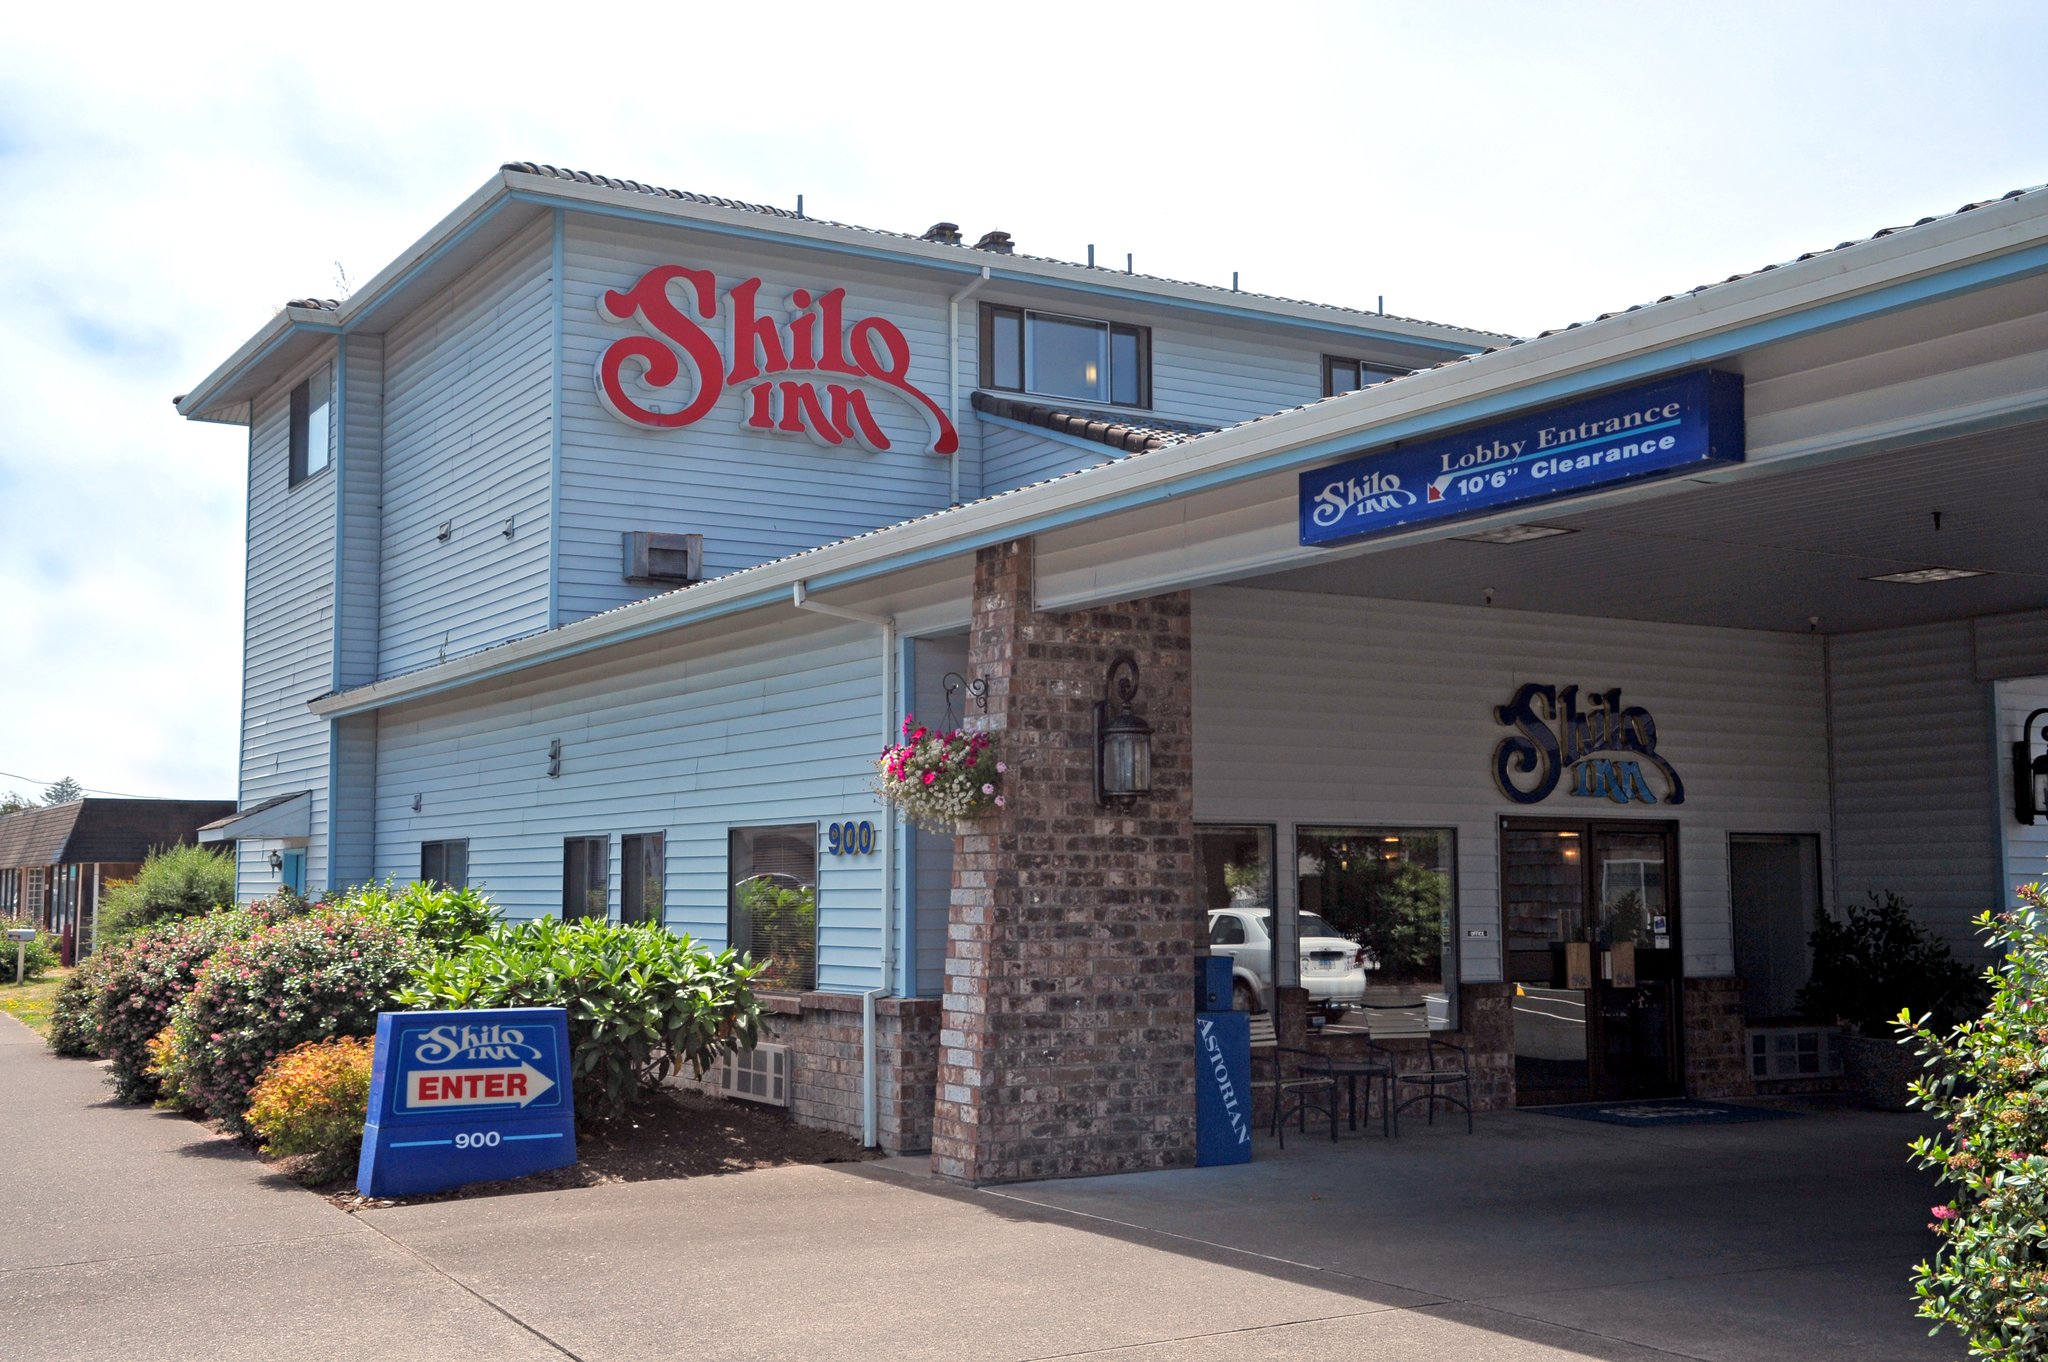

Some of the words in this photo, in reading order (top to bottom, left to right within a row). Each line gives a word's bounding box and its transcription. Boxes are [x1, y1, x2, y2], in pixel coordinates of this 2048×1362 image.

[597, 264, 959, 456] Shilo
[1440, 438, 1527, 474] Lobby
[1538, 401, 1681, 449] Entrance
[1530, 434, 1676, 480] Clearance
[1313, 471, 1417, 527] Shilo
[1492, 683, 1685, 804] Shilo
[828, 820, 875, 856] 900
[415, 1024, 543, 1064] Shilo
[418, 1073, 528, 1101] ENTER
[1197, 1016, 1251, 1145] ASTORIAN
[455, 1131, 501, 1149] 900
